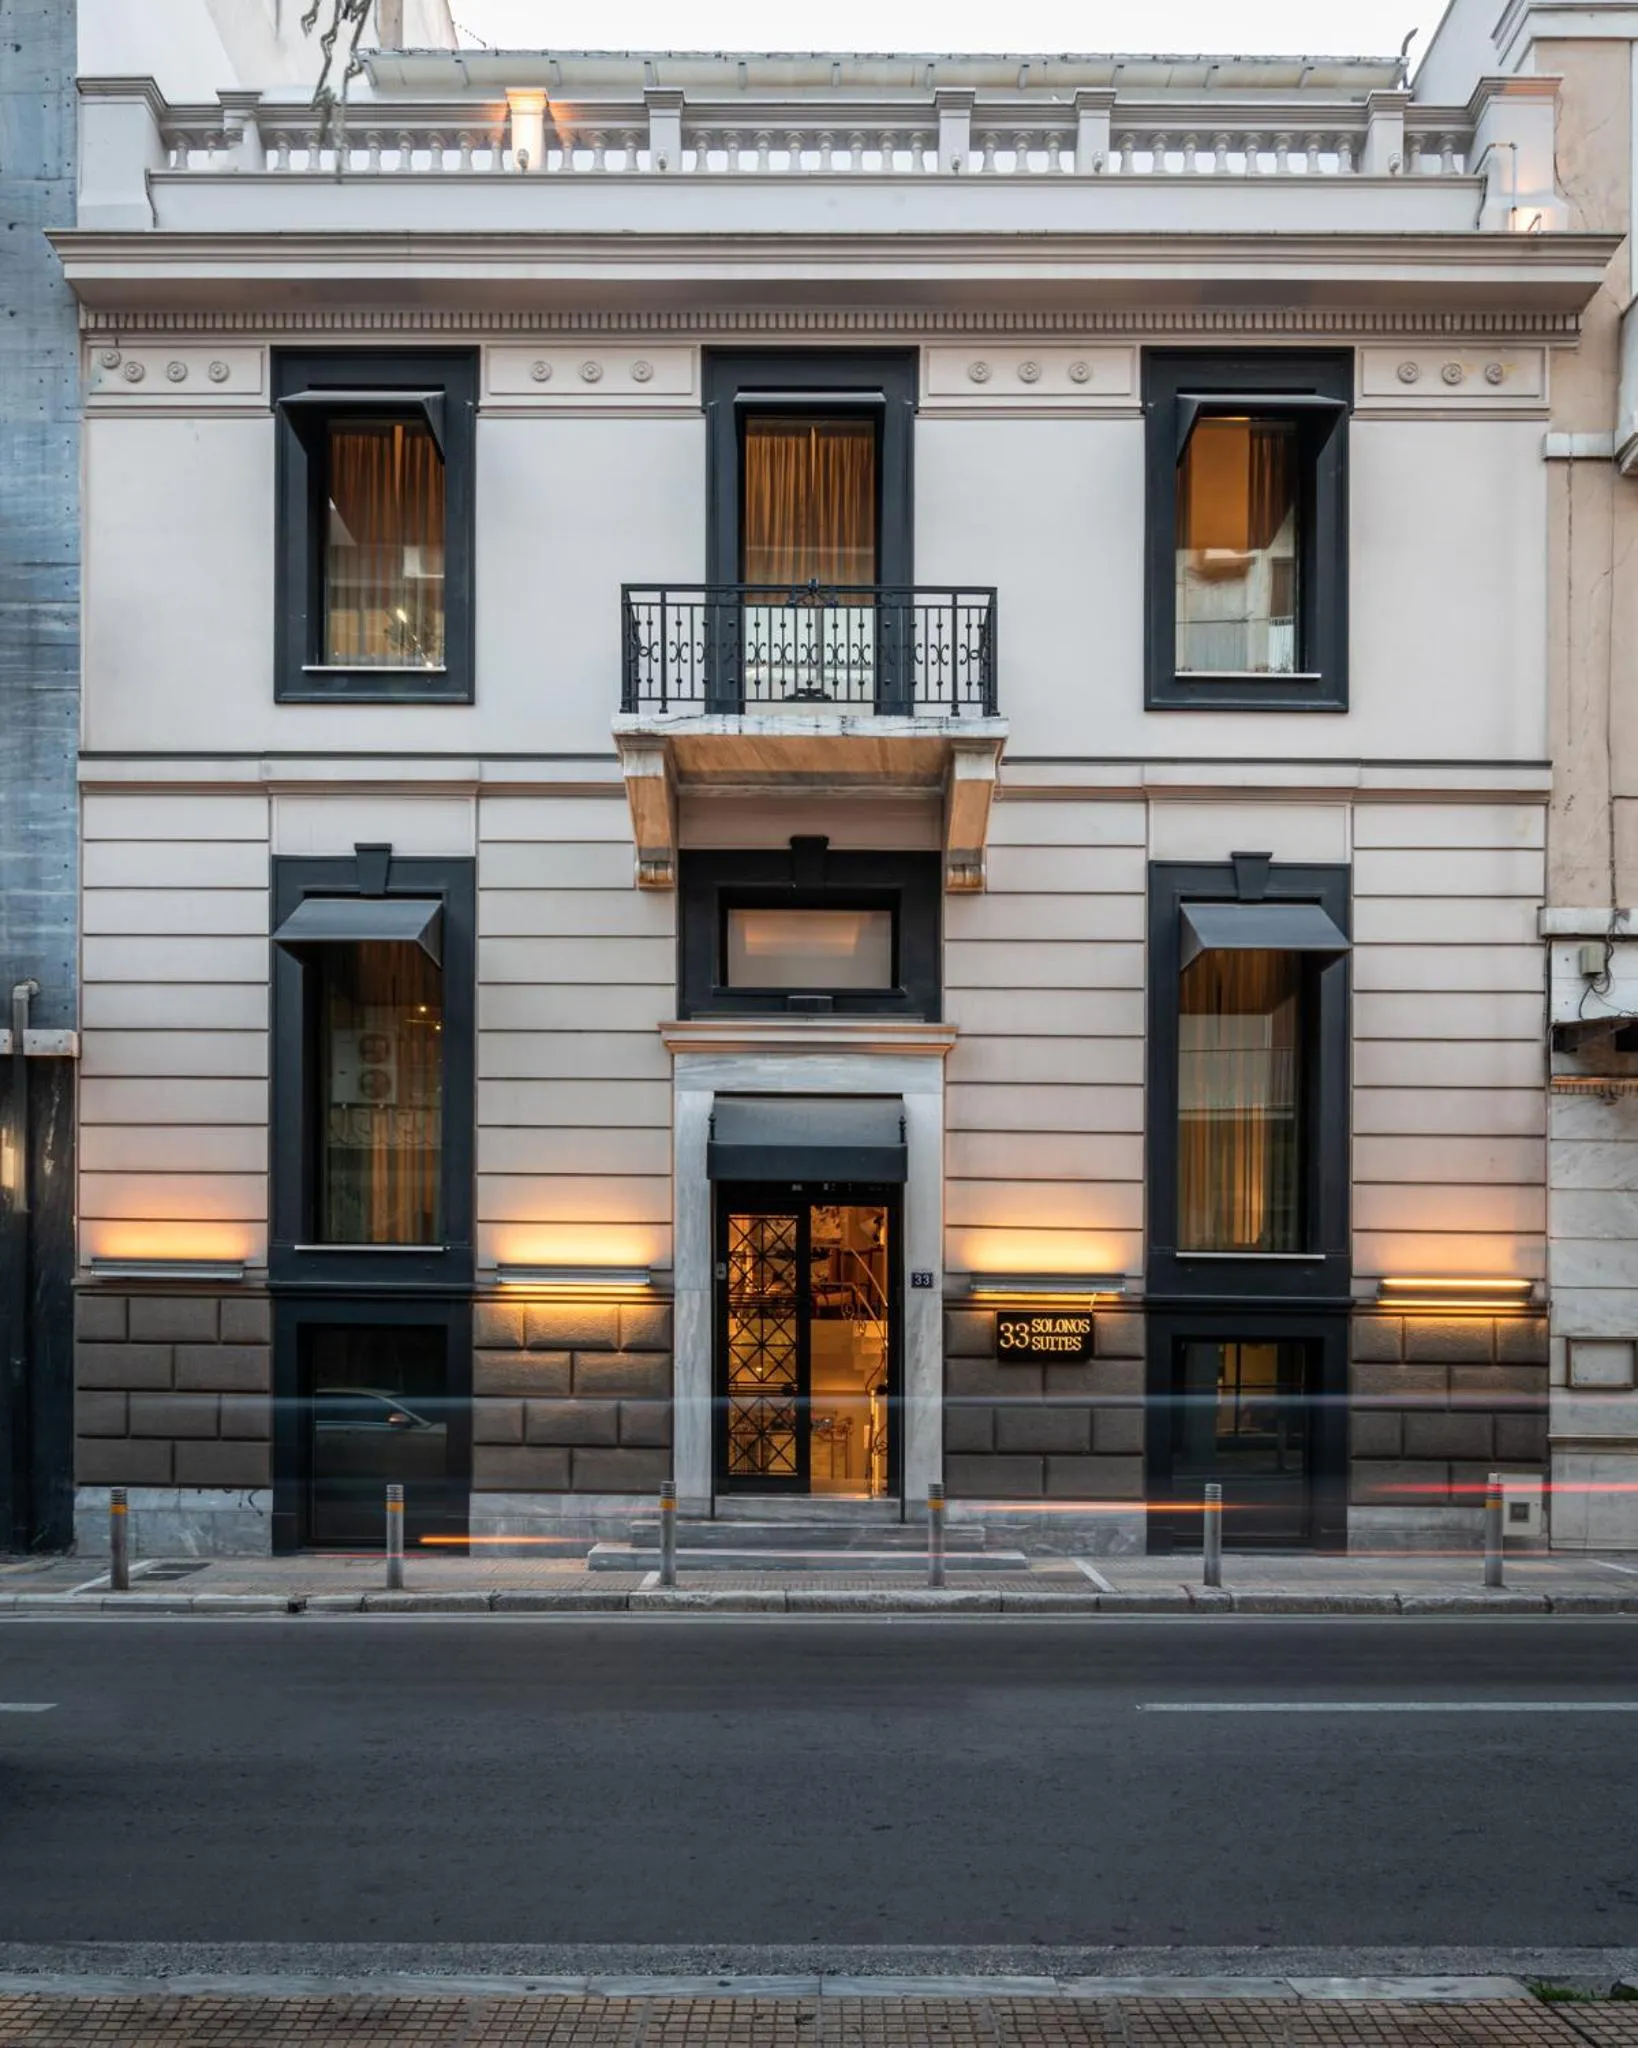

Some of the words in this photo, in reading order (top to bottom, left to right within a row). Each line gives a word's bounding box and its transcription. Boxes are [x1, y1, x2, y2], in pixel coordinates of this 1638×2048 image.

[914, 1274, 930, 1286] 33
[1031, 1318, 1090, 1333] SOLONOS
[1000, 1322, 1029, 1349] 33
[1031, 1336, 1082, 1351] SUITES
